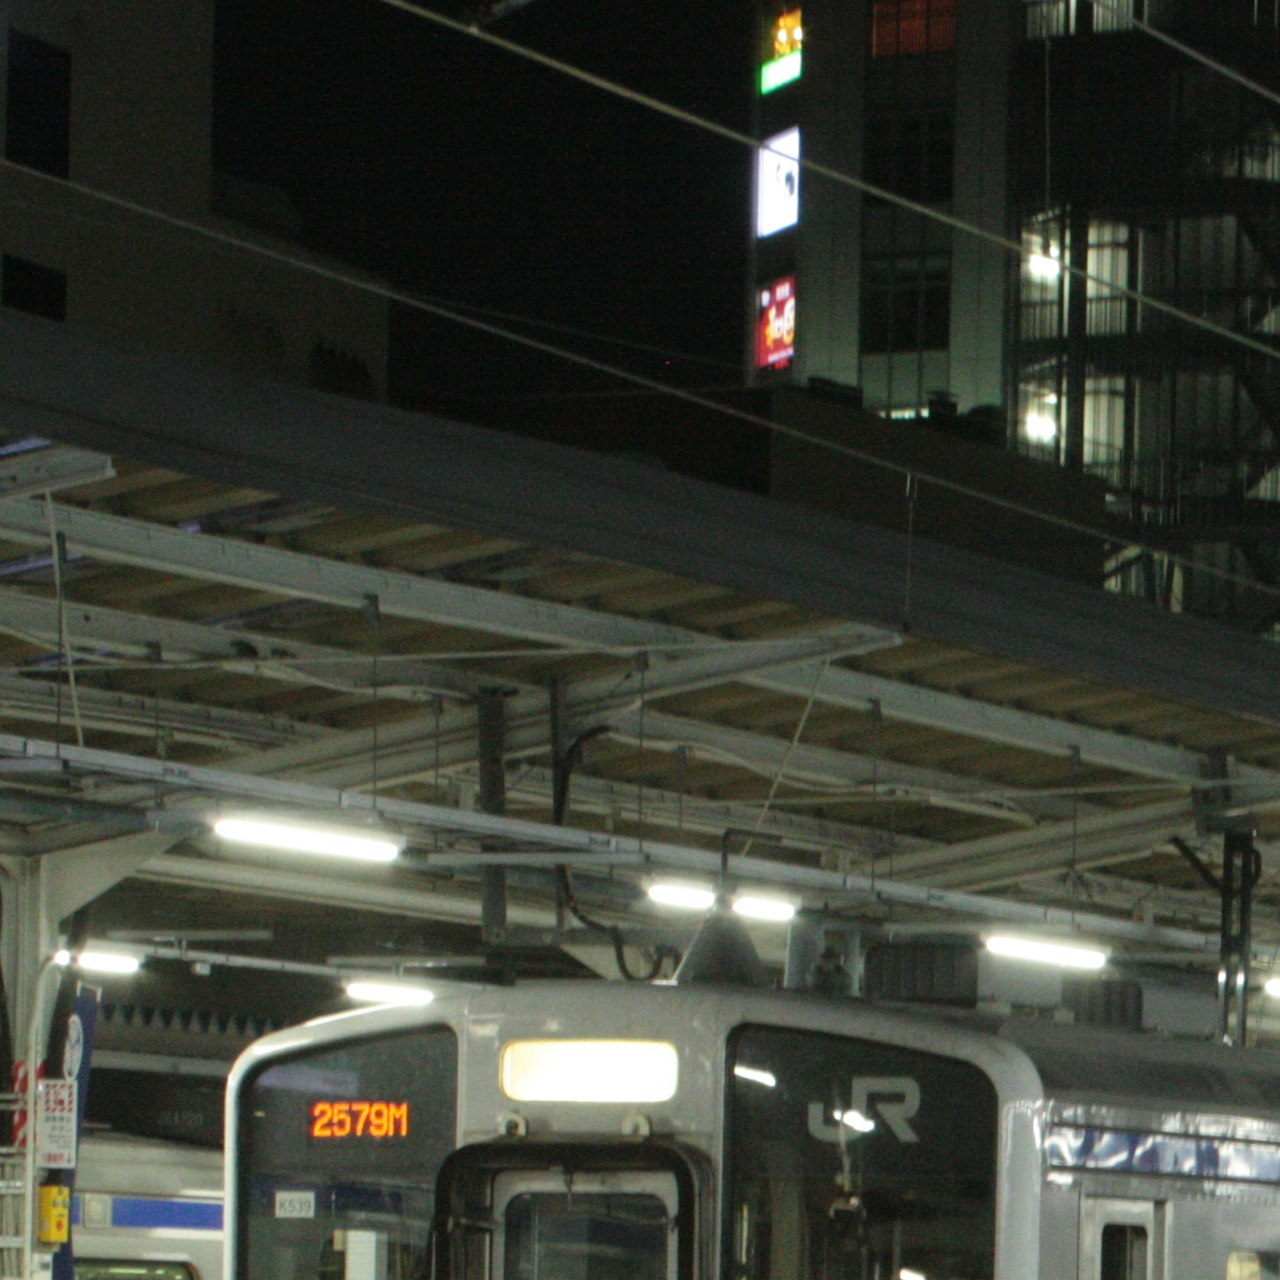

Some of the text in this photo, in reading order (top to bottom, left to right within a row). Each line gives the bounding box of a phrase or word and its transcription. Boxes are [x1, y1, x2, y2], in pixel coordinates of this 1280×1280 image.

[312, 1101, 409, 1137] 2579M
[807, 1076, 921, 1143] JR
[279, 1198, 312, 1214] K539
